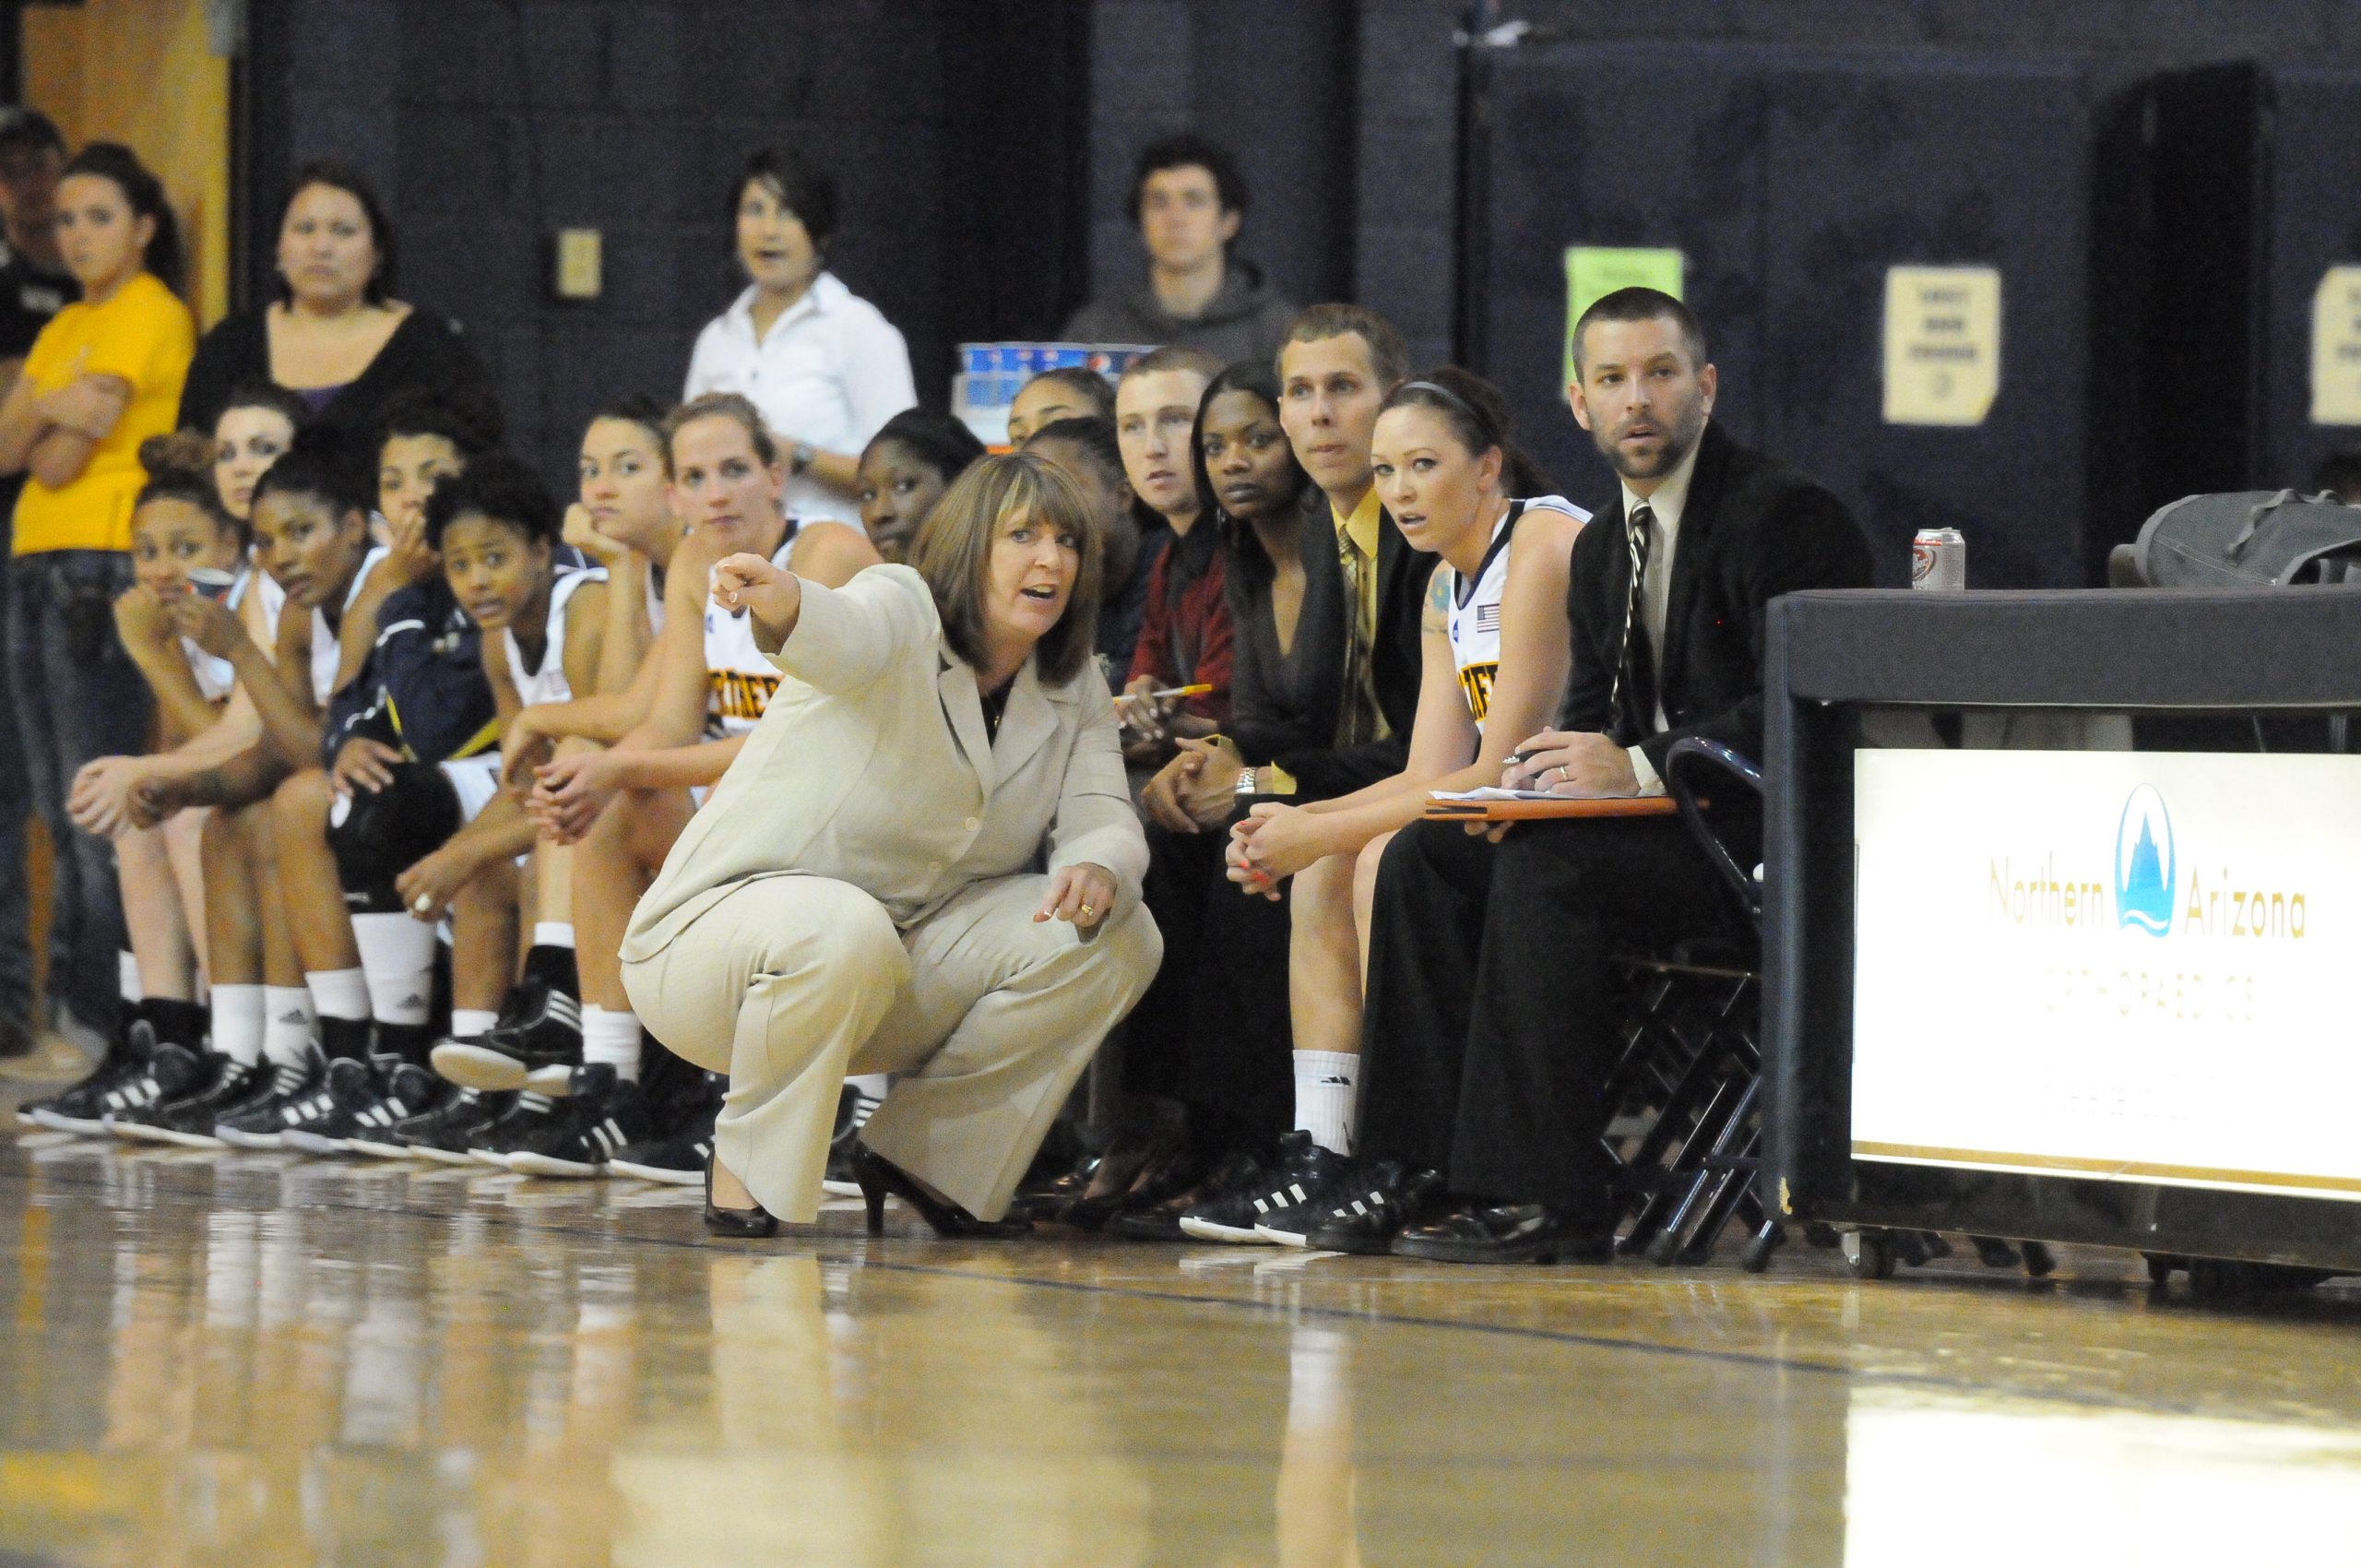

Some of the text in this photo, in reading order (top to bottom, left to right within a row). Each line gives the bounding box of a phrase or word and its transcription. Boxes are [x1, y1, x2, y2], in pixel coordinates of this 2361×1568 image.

[1990, 851, 2306, 939] Northern Arizona
[2042, 965, 2258, 1025] OOPAEDCS
